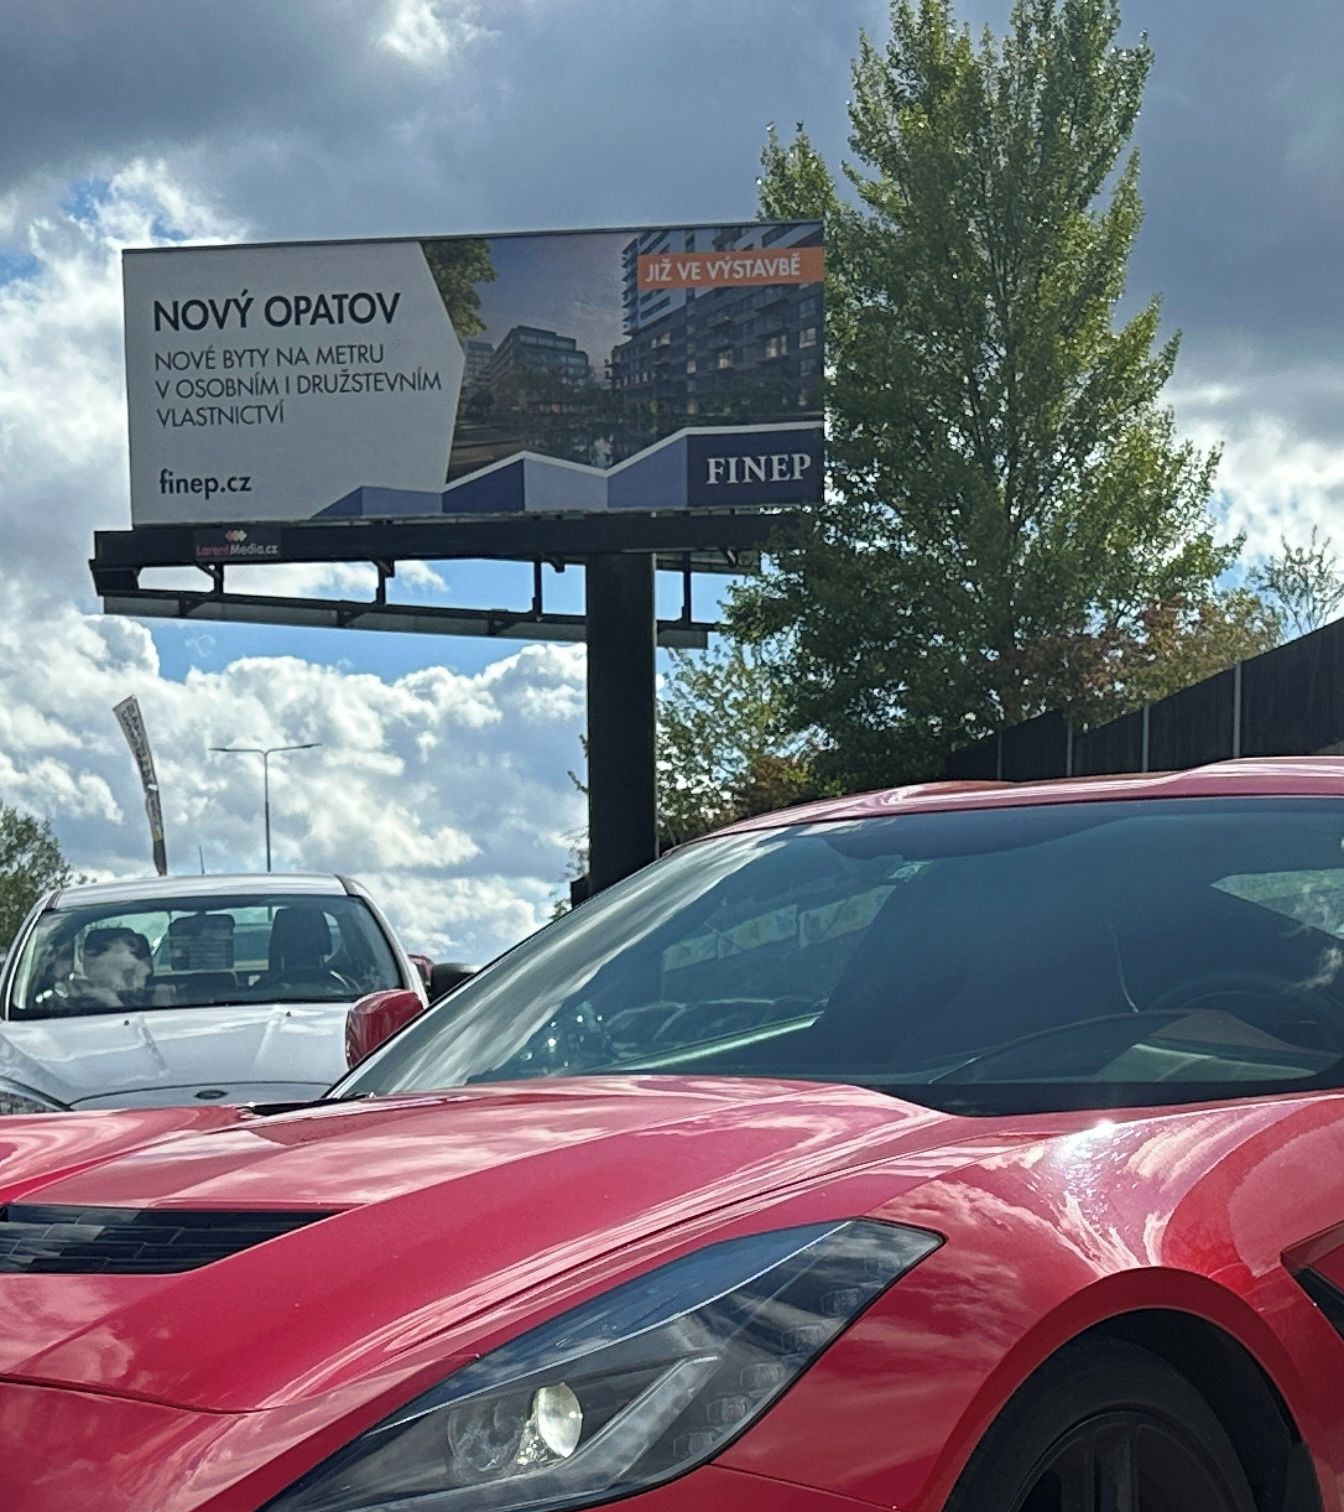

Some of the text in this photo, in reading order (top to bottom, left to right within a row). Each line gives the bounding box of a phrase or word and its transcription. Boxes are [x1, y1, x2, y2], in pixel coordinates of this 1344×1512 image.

[645, 251, 802, 283] JIŽ VE VÝSTAVBĚ
[153, 288, 402, 332] NOVÝ OPATOV
[155, 343, 385, 372] NOVÉ BYTY NA METRU
[155, 365, 443, 400] V OSOBNÍM I DRUŽSTEVNÍM
[156, 399, 286, 428] VLASTNICTVÍ
[159, 467, 253, 501] finep.cz
[706, 453, 812, 485] FINEP
